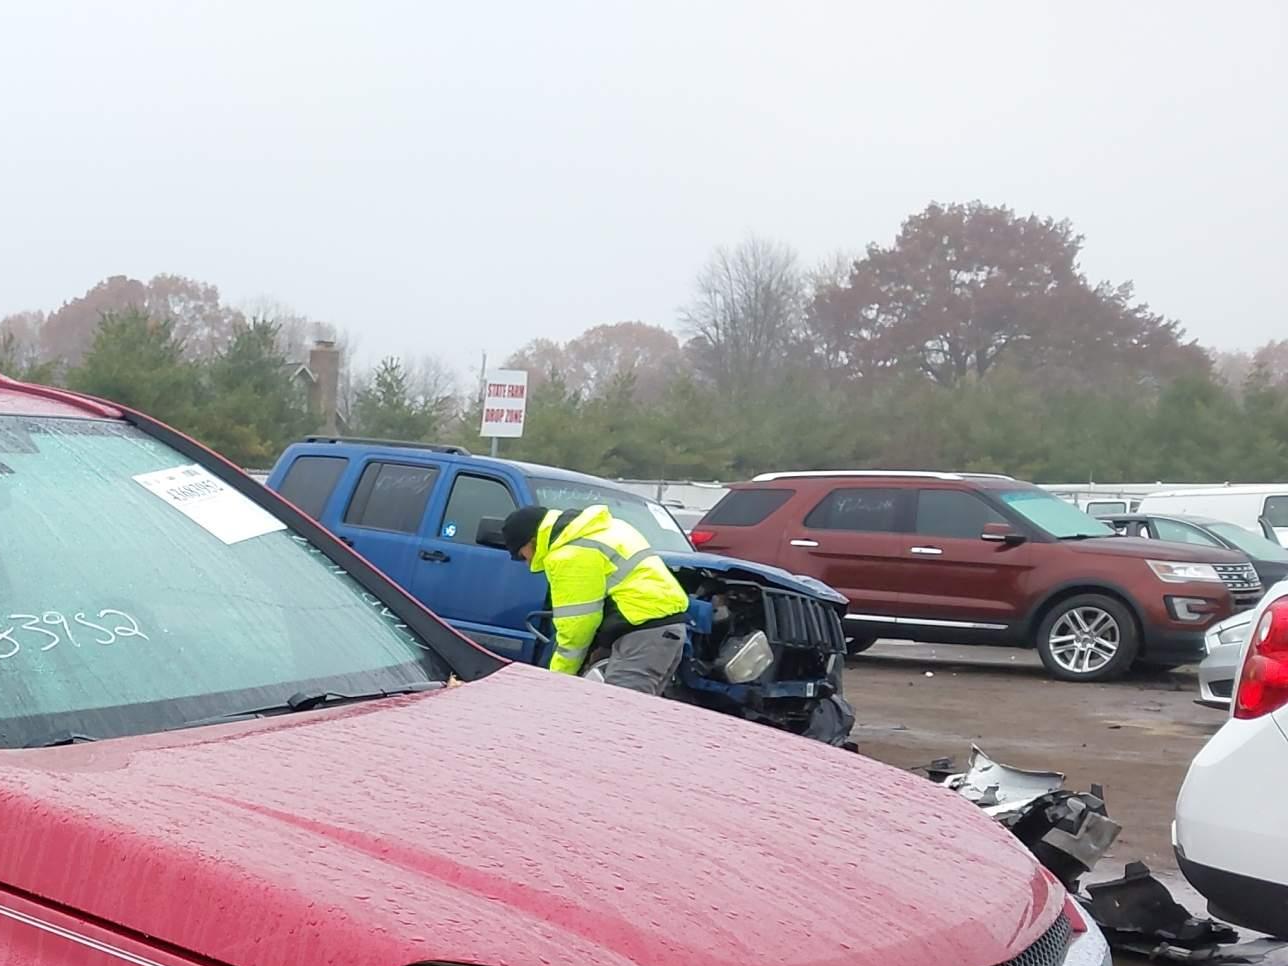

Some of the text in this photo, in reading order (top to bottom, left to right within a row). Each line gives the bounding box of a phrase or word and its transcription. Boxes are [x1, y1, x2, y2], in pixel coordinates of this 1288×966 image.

[488, 383, 525, 399] STATE FARM
[485, 408, 523, 423] DROP ZONE
